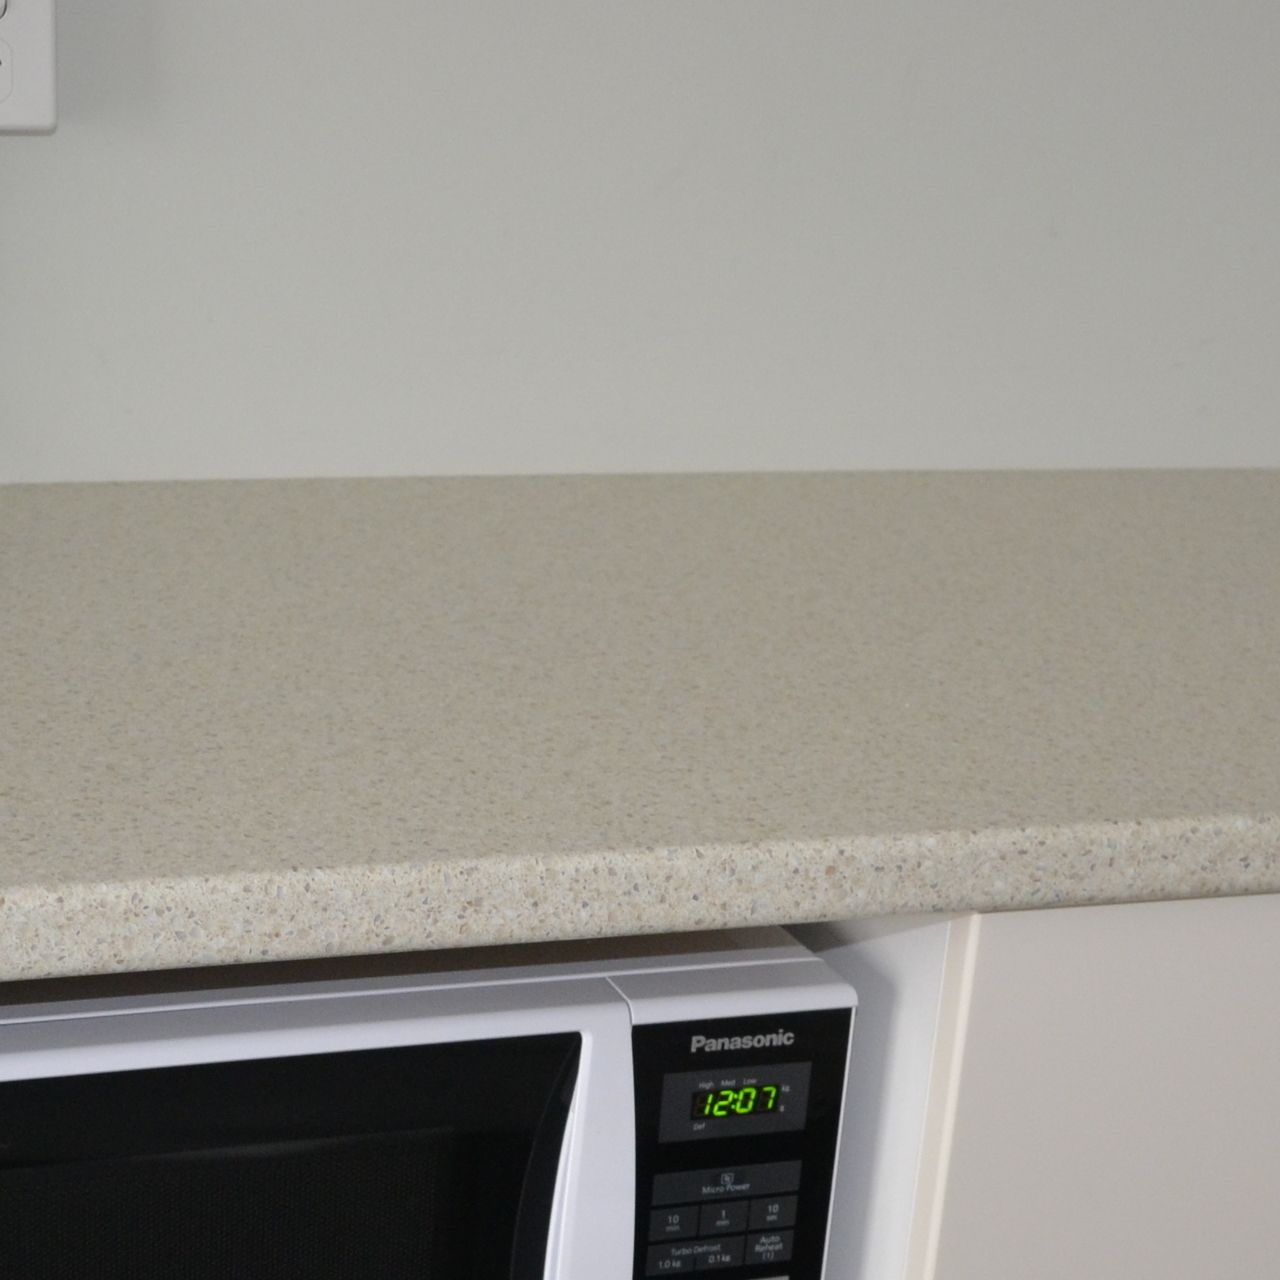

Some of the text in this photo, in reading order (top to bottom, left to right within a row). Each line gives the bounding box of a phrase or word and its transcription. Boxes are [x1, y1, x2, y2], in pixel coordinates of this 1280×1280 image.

[690, 1027, 795, 1053] Panasonic
[699, 1078, 757, 1091] High Med Low
[703, 1086, 778, 1117] 12:07
[693, 1121, 707, 1131] Def
[702, 1183, 751, 1195] Micro Power
[768, 1204, 779, 1213] 10
[721, 1209, 726, 1219] 1
[667, 1215, 680, 1224] 10
[760, 1235, 781, 1244] Auto
[671, 1243, 721, 1256] Turbo Defrost
[754, 1242, 783, 1252] Reheat
[659, 1259, 671, 1269] 1.0
